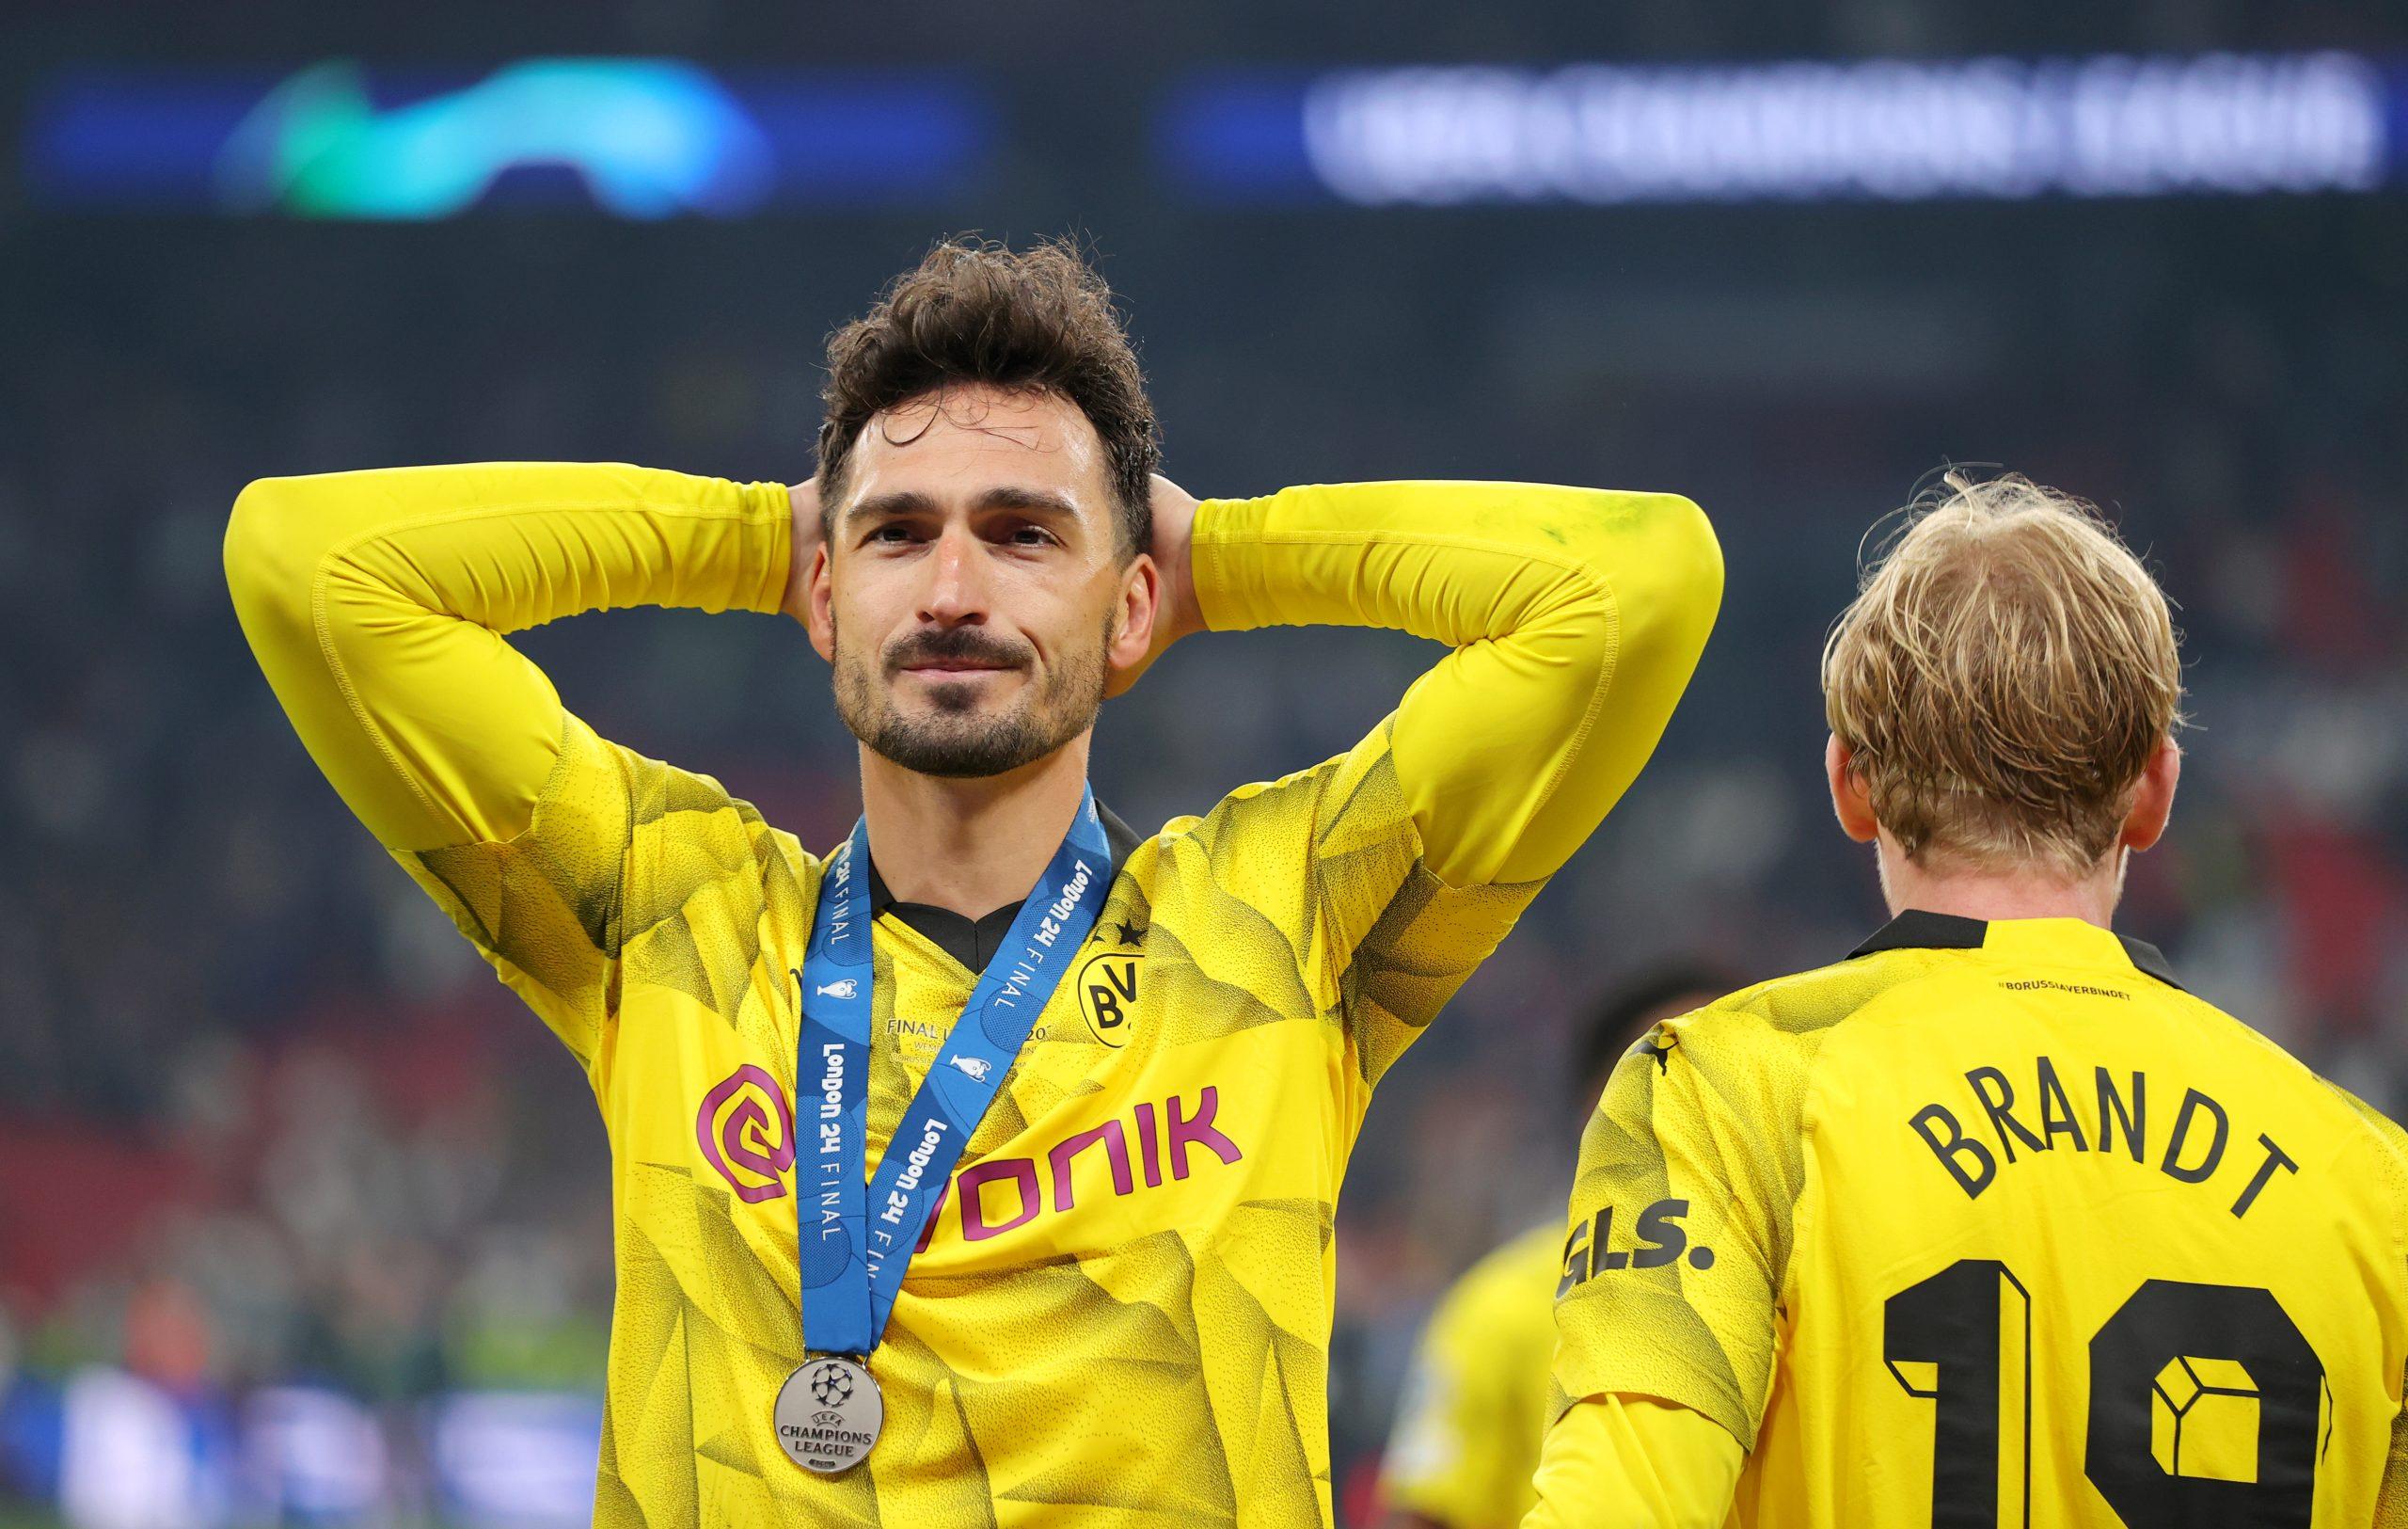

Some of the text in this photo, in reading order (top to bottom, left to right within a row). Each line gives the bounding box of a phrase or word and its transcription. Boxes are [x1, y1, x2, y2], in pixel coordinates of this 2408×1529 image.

[832, 887, 850, 945] FINAL
[1033, 916, 1061, 948] 24
[994, 948, 1044, 1008] FINAL
[1088, 962, 1136, 1029] BV
[887, 1019, 938, 1040] FINAL
[819, 1123, 841, 1155] 24
[1909, 1056, 2299, 1220] BRANDT
[820, 1163, 842, 1242] FINAL
[880, 1190, 909, 1225] 24
[867, 1230, 892, 1286] FIN
[1555, 1199, 1715, 1299] GLS.
[812, 1413, 843, 1426] UEFA
[1884, 1259, 2332, 1529] 19
[780, 1425, 873, 1445] CHAMPIONS
[795, 1441, 854, 1457] LEAGUE
